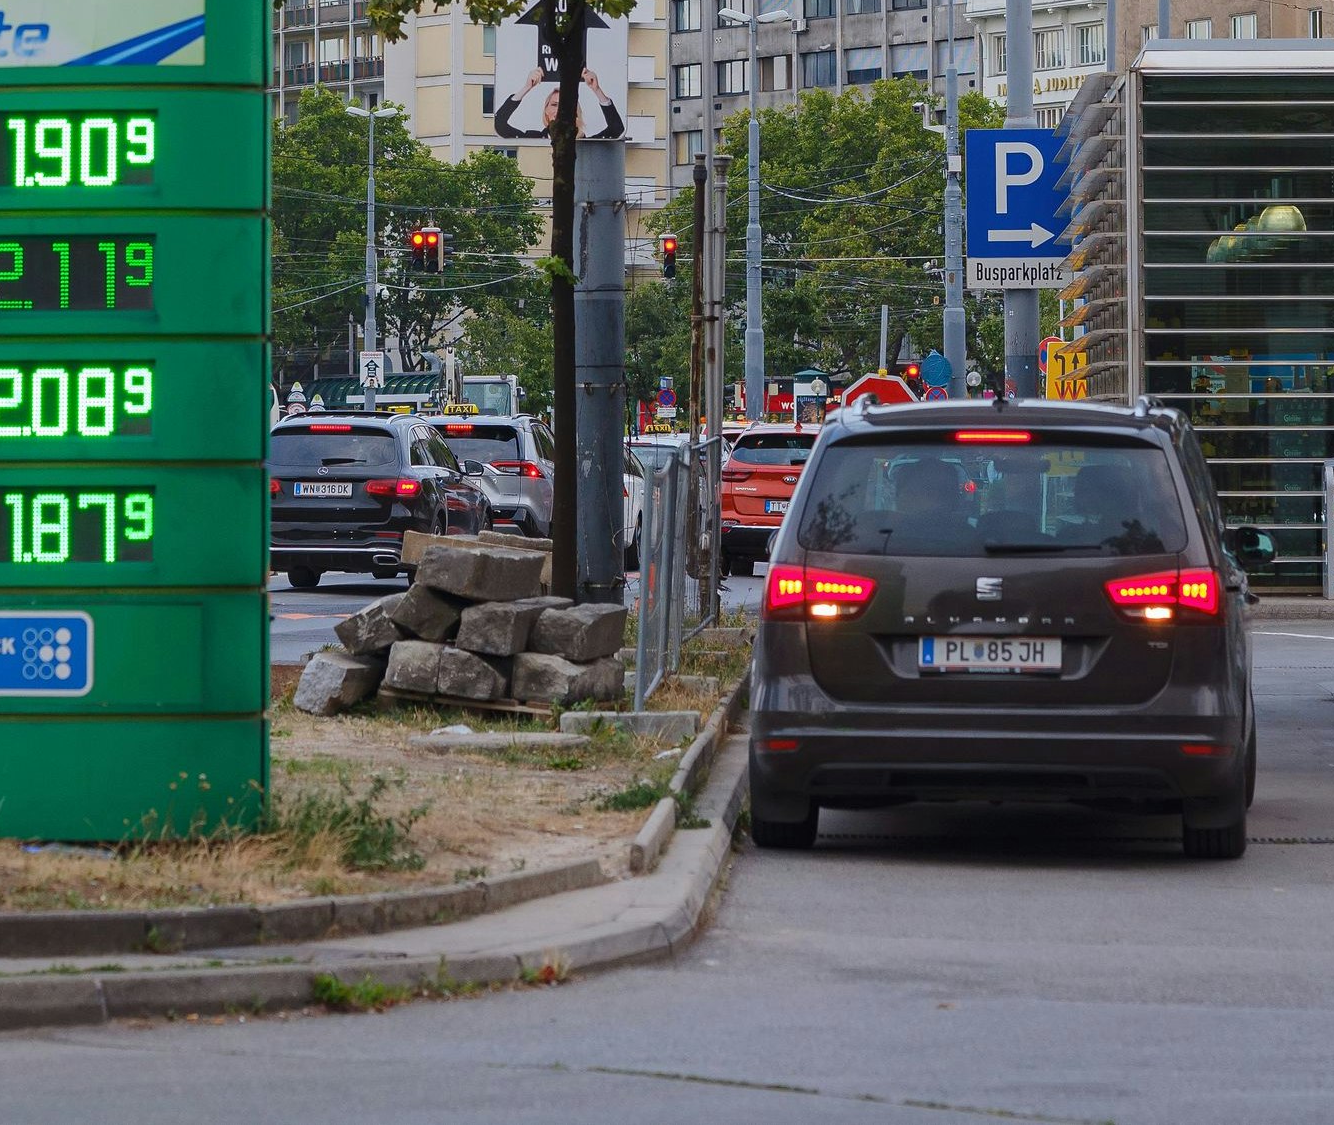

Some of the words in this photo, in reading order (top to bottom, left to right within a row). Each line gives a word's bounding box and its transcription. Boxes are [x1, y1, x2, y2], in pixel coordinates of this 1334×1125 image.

[995, 142, 1044, 214] P
[976, 263, 1063, 287] Busparkplatz
[303, 485, 315, 494] WN
[321, 485, 336, 494] 316
[338, 485, 348, 493] DK
[946, 641, 969, 662] PL
[987, 641, 1013, 662] 85
[1019, 642, 1045, 662] JH
